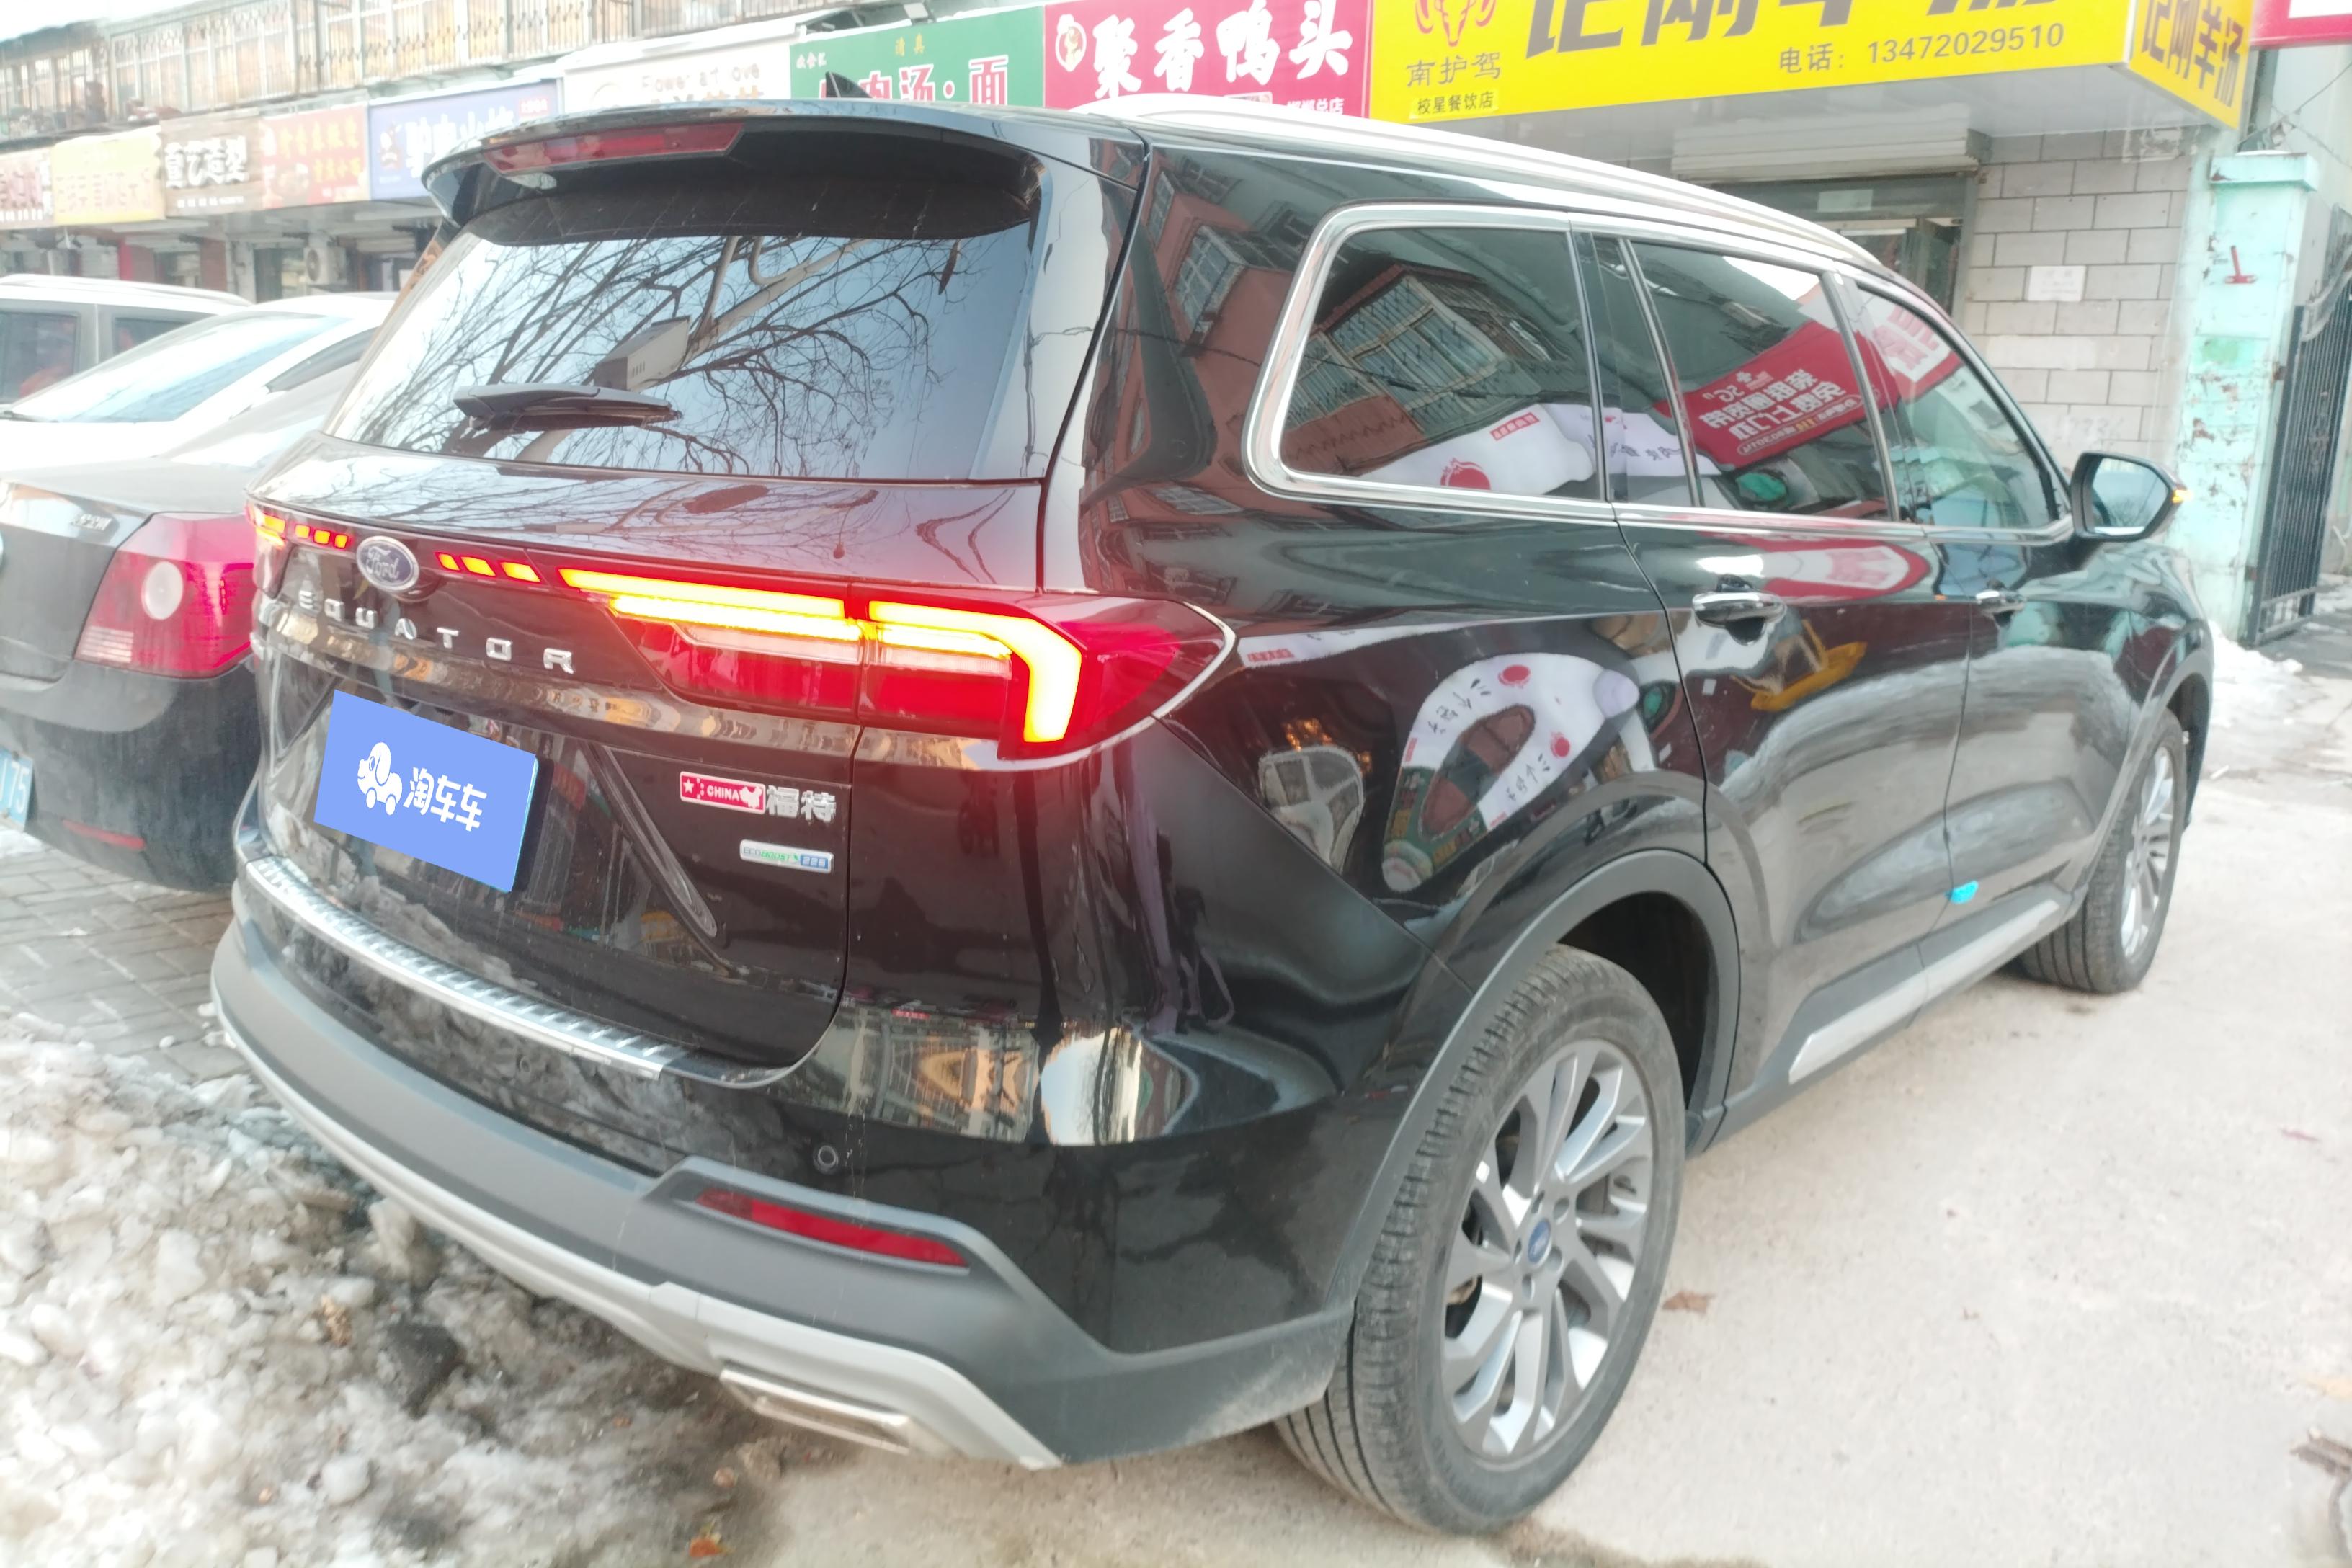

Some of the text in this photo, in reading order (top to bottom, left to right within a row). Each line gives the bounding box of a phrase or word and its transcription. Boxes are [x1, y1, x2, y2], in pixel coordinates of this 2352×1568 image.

[1092, 0, 1353, 98] 聚香鸭头
[1869, 24, 2064, 64] 13472029510
[819, 55, 1008, 105] 肉汤·面
[1407, 52, 1501, 87] 南护驾
[1418, 92, 1494, 115] 校星餐饮店
[365, 545, 400, 580] Ford
[299, 589, 574, 674] EQUATOR
[707, 785, 740, 802] CHINA
[767, 785, 837, 823] 福特
